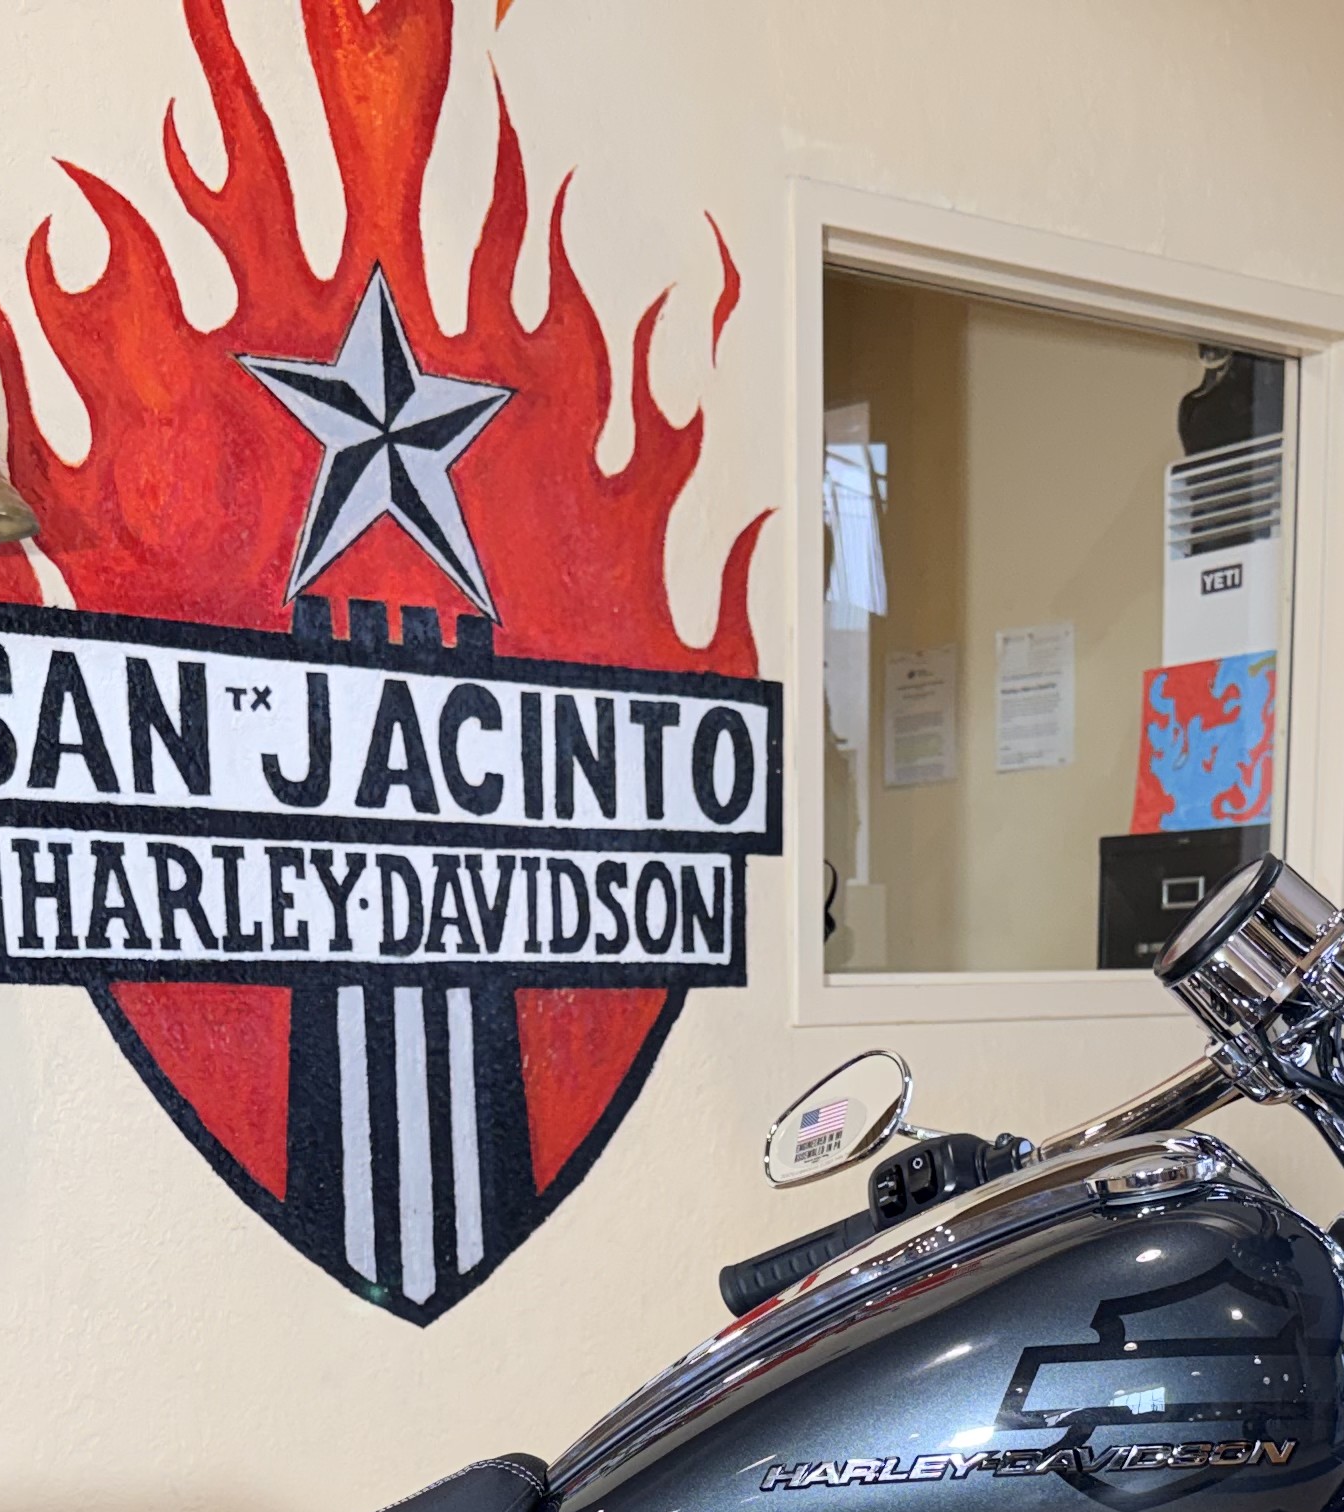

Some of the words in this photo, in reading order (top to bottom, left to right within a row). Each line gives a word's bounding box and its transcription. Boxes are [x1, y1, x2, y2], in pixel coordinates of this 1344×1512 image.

[1203, 568, 1240, 591] YETI
[225, 685, 273, 713] TX
[260, 671, 755, 825] JACINTO
[759, 1437, 1299, 1491] HARLEY-DAVIDSON
